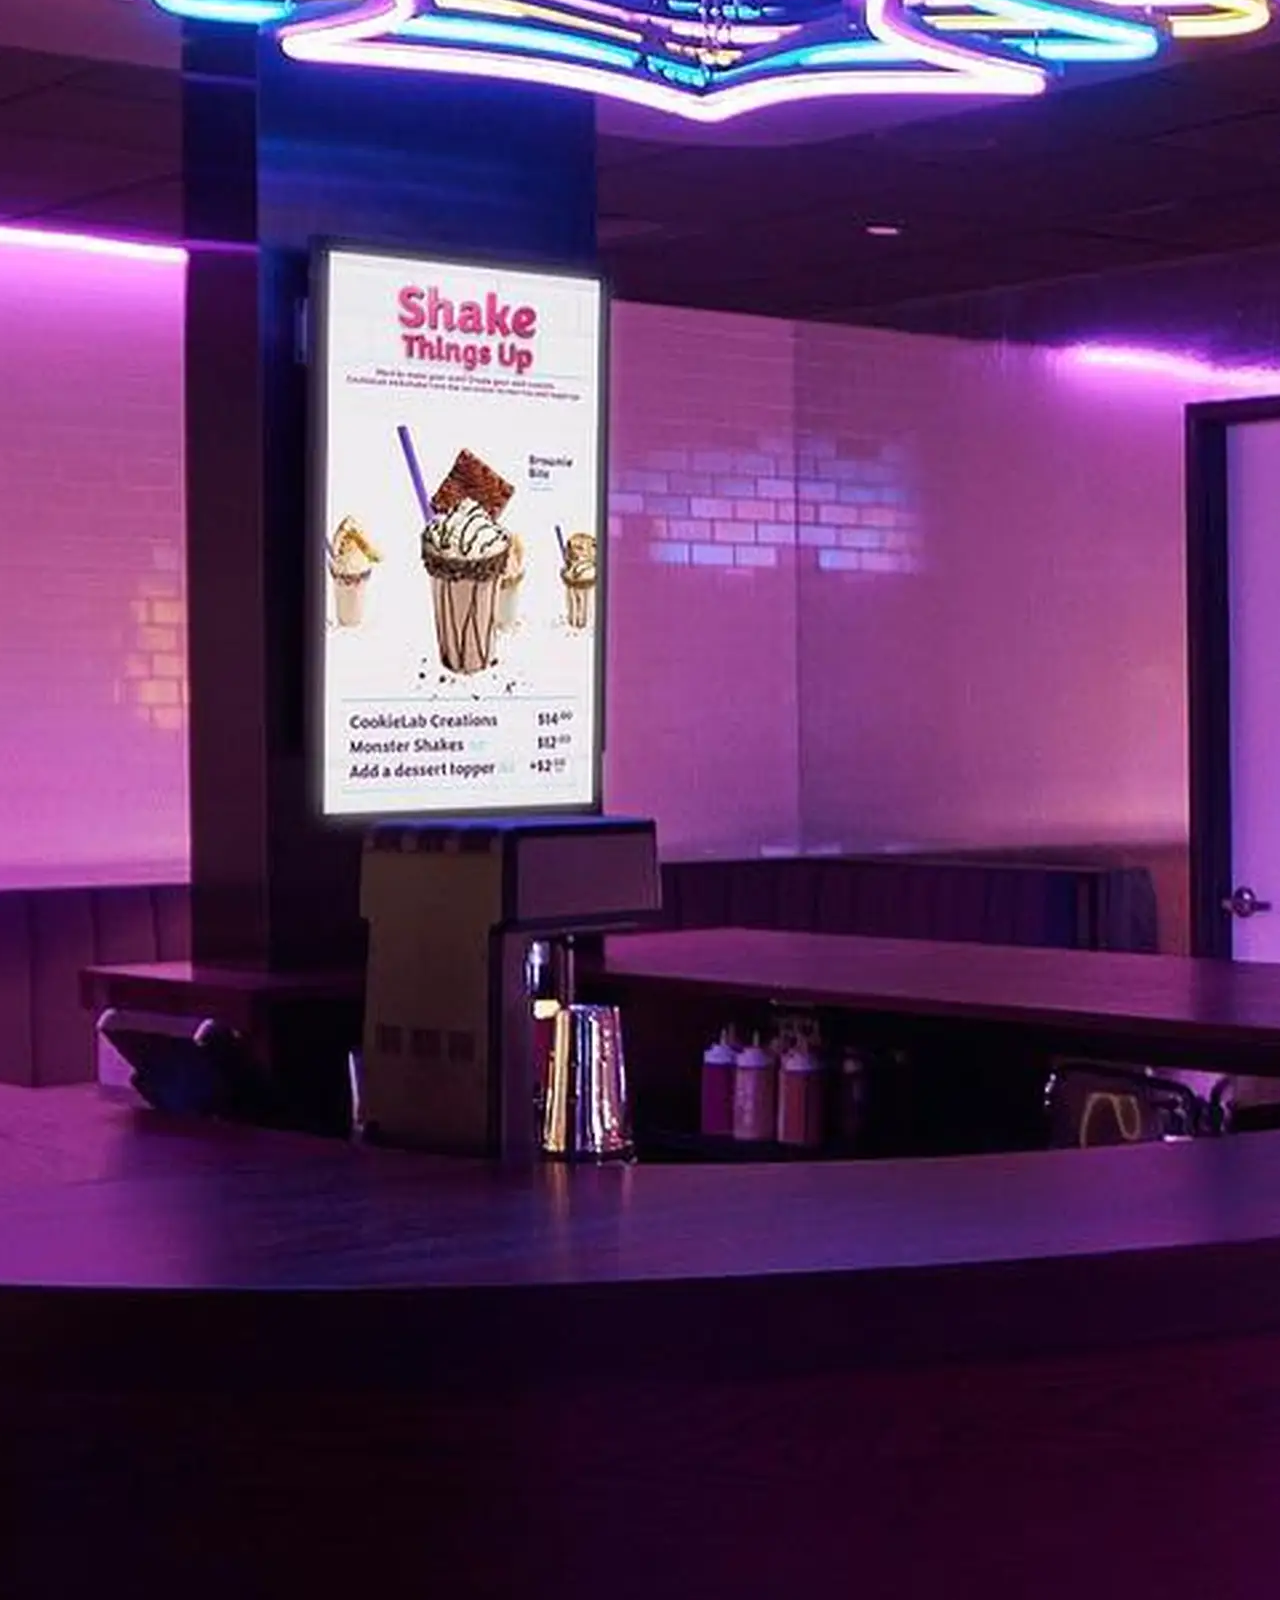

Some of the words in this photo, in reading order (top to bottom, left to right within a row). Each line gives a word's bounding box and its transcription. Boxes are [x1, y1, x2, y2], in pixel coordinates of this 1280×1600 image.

[398, 284, 536, 338] Shake
[402, 333, 491, 371] Things
[498, 342, 533, 374] Up
[349, 712, 427, 729] CookieLab
[430, 712, 498, 729] Creations
[349, 740, 410, 754] Monster
[414, 738, 464, 753] Shakes
[349, 763, 380, 779] Add
[382, 766, 391, 778] a
[394, 761, 447, 778] dessert
[450, 761, 496, 779] topper
